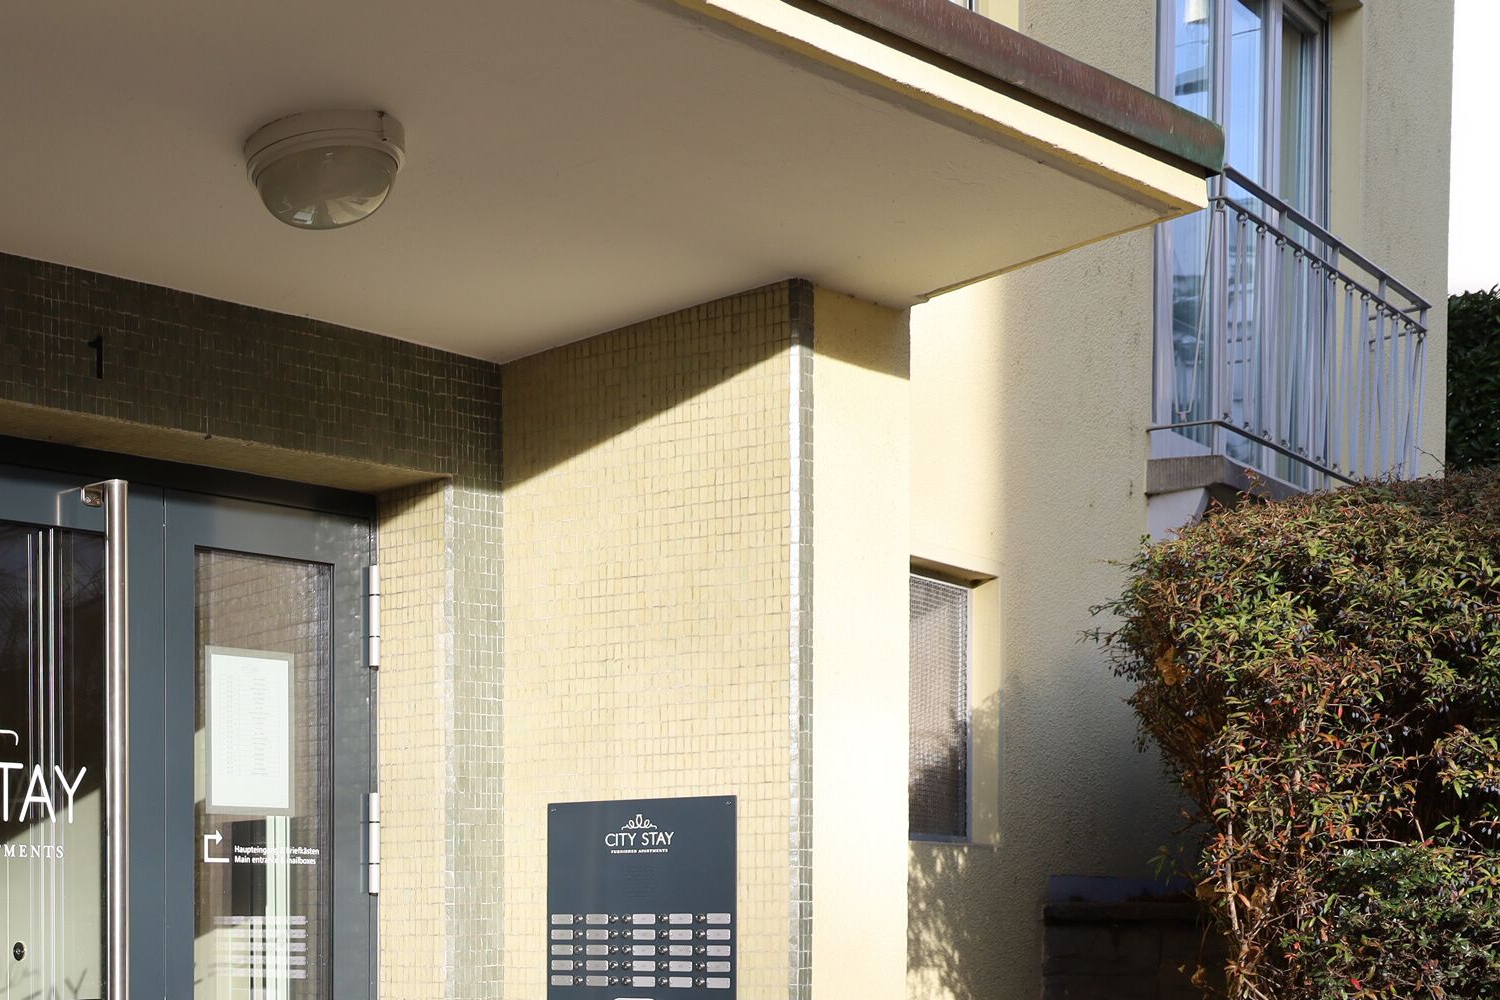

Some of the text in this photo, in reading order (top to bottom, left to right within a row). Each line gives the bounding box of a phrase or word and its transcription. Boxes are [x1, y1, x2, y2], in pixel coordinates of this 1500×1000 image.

[88, 336, 103, 379] 1
[605, 832, 674, 847] CITY STAY
[234, 855, 250, 863] Main
